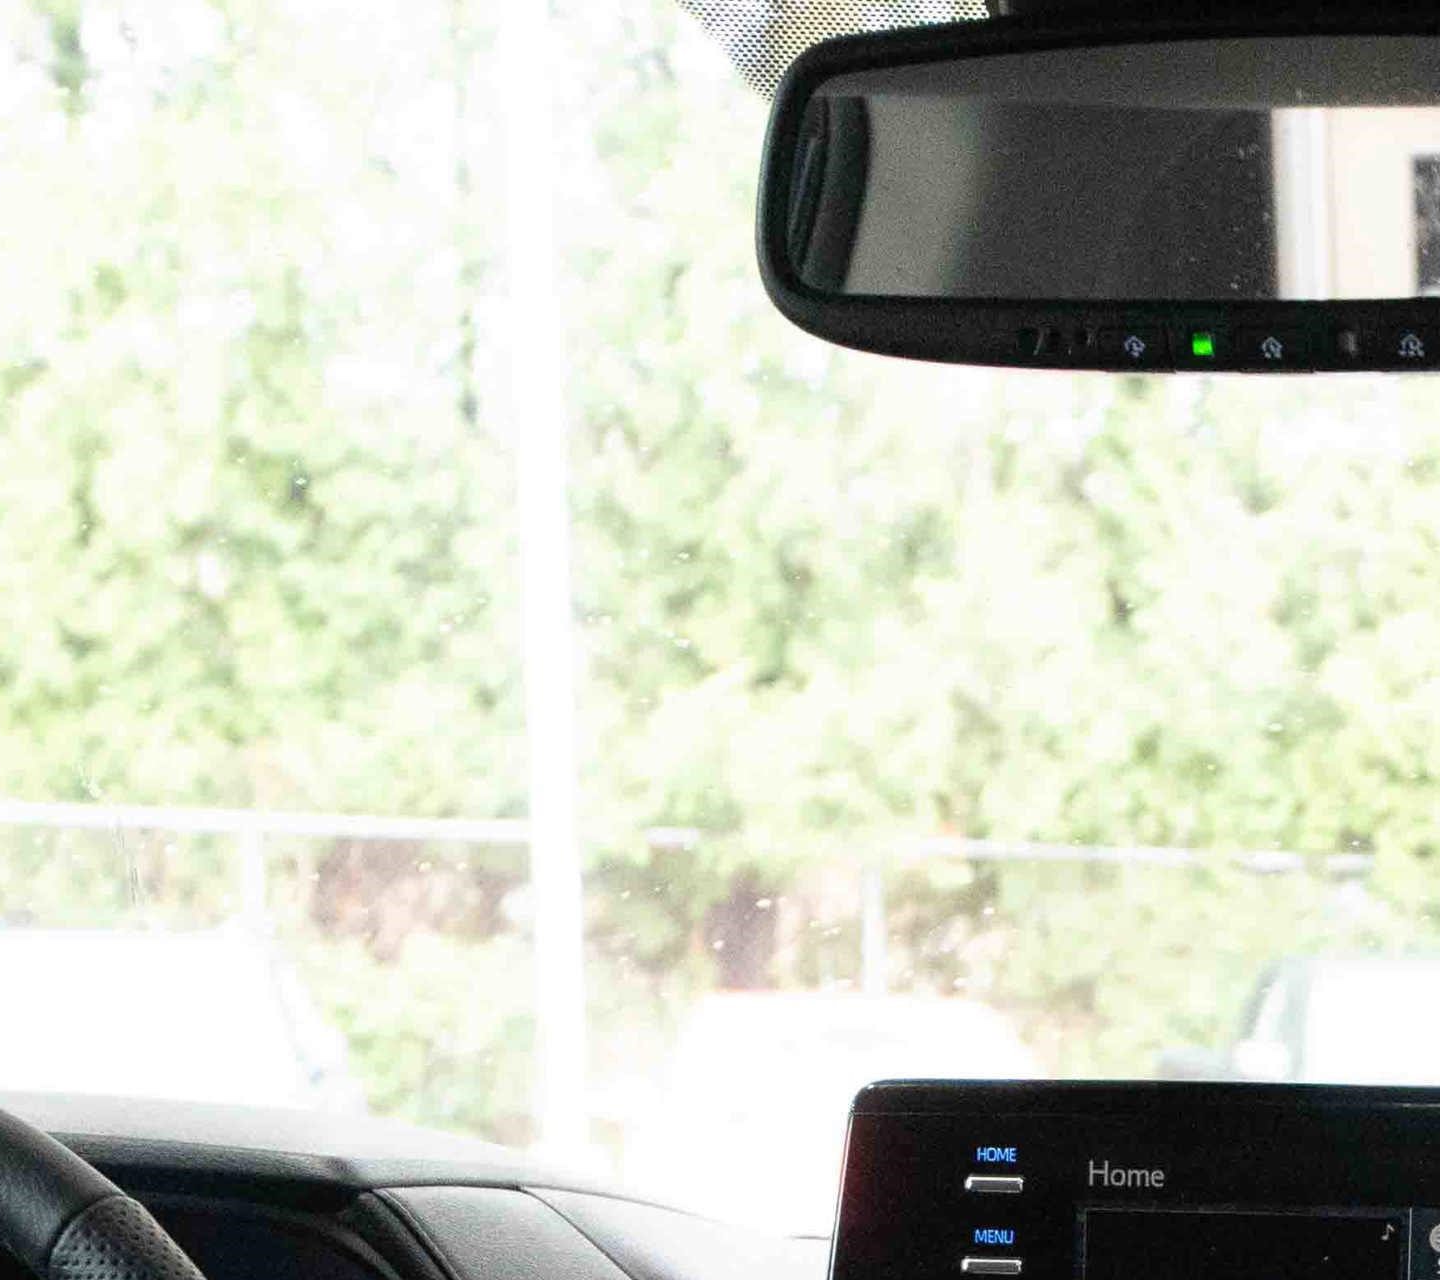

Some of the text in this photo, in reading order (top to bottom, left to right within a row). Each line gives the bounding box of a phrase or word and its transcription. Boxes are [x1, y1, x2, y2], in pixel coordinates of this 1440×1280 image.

[976, 1147, 1017, 1163] HOME
[1088, 1160, 1165, 1188] Home
[974, 1229, 1015, 1245] MENU
